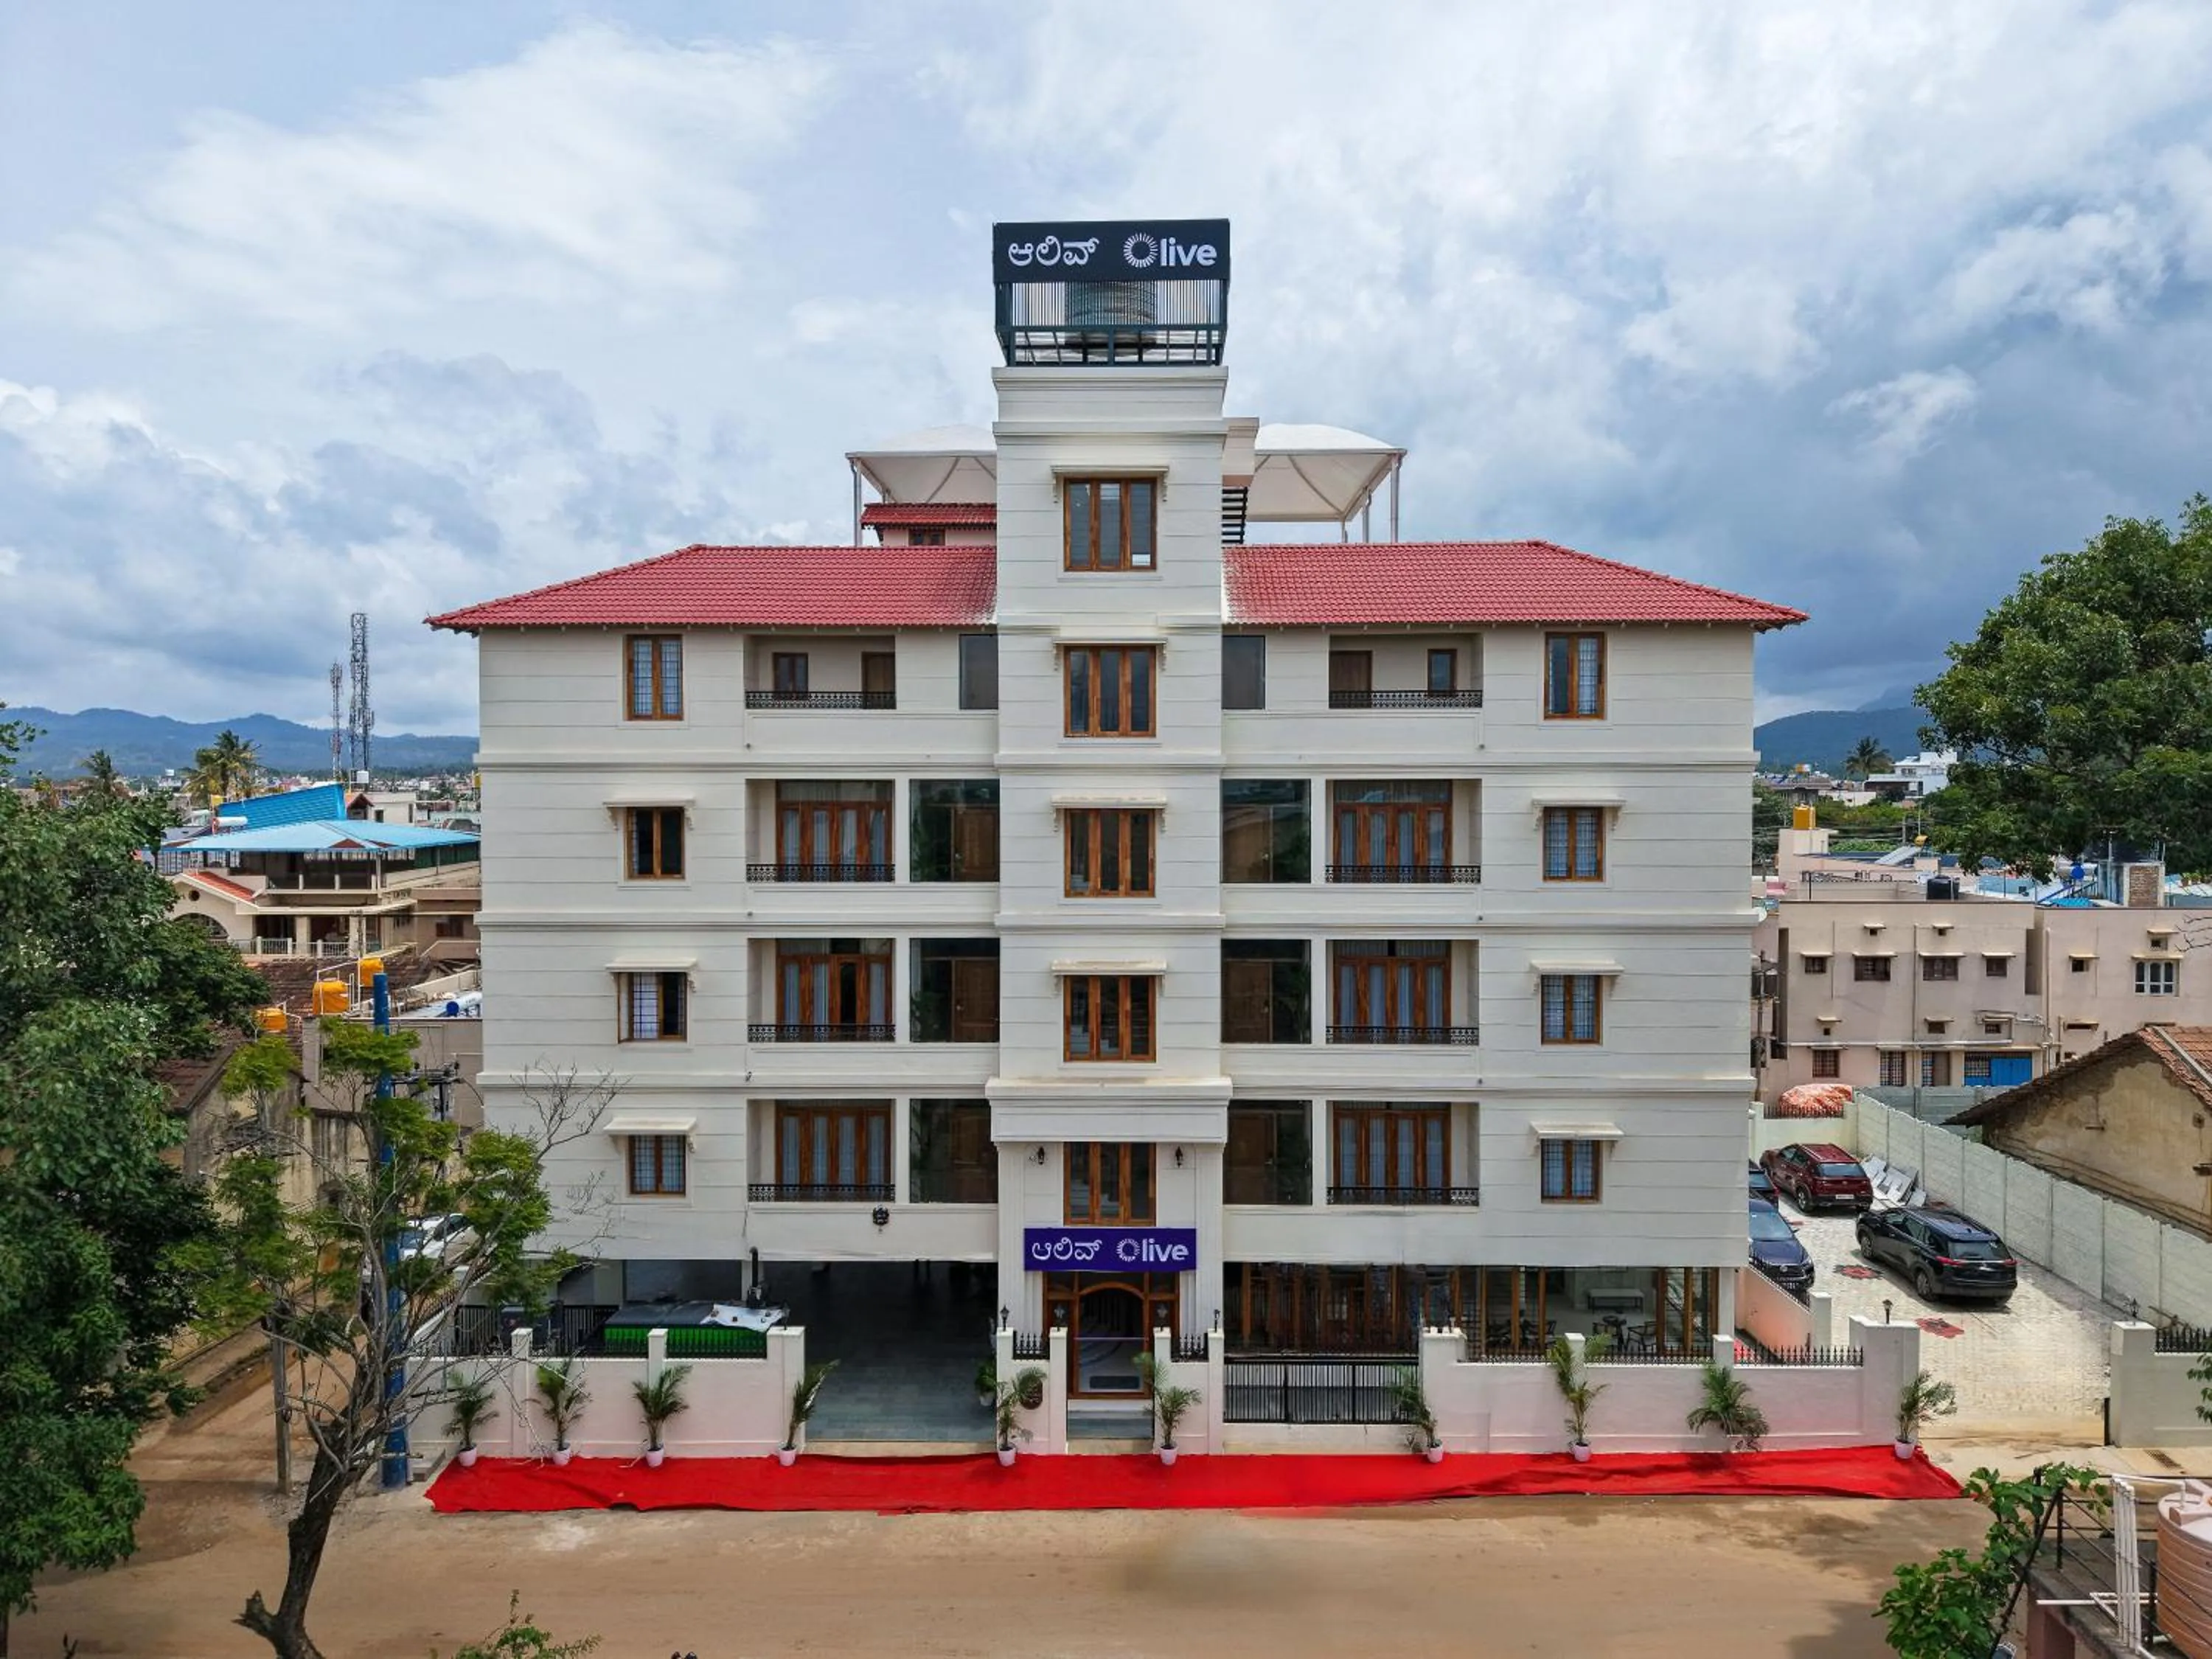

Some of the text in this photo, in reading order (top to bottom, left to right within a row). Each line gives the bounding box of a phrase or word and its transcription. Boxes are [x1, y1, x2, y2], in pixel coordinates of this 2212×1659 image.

[1008, 235, 1099, 266] ಆಲಿವ್
[1123, 232, 1217, 268] Olive
[1032, 1237, 1102, 1260] ಆಲಿವ್
[1116, 1238, 1189, 1262] Olive
